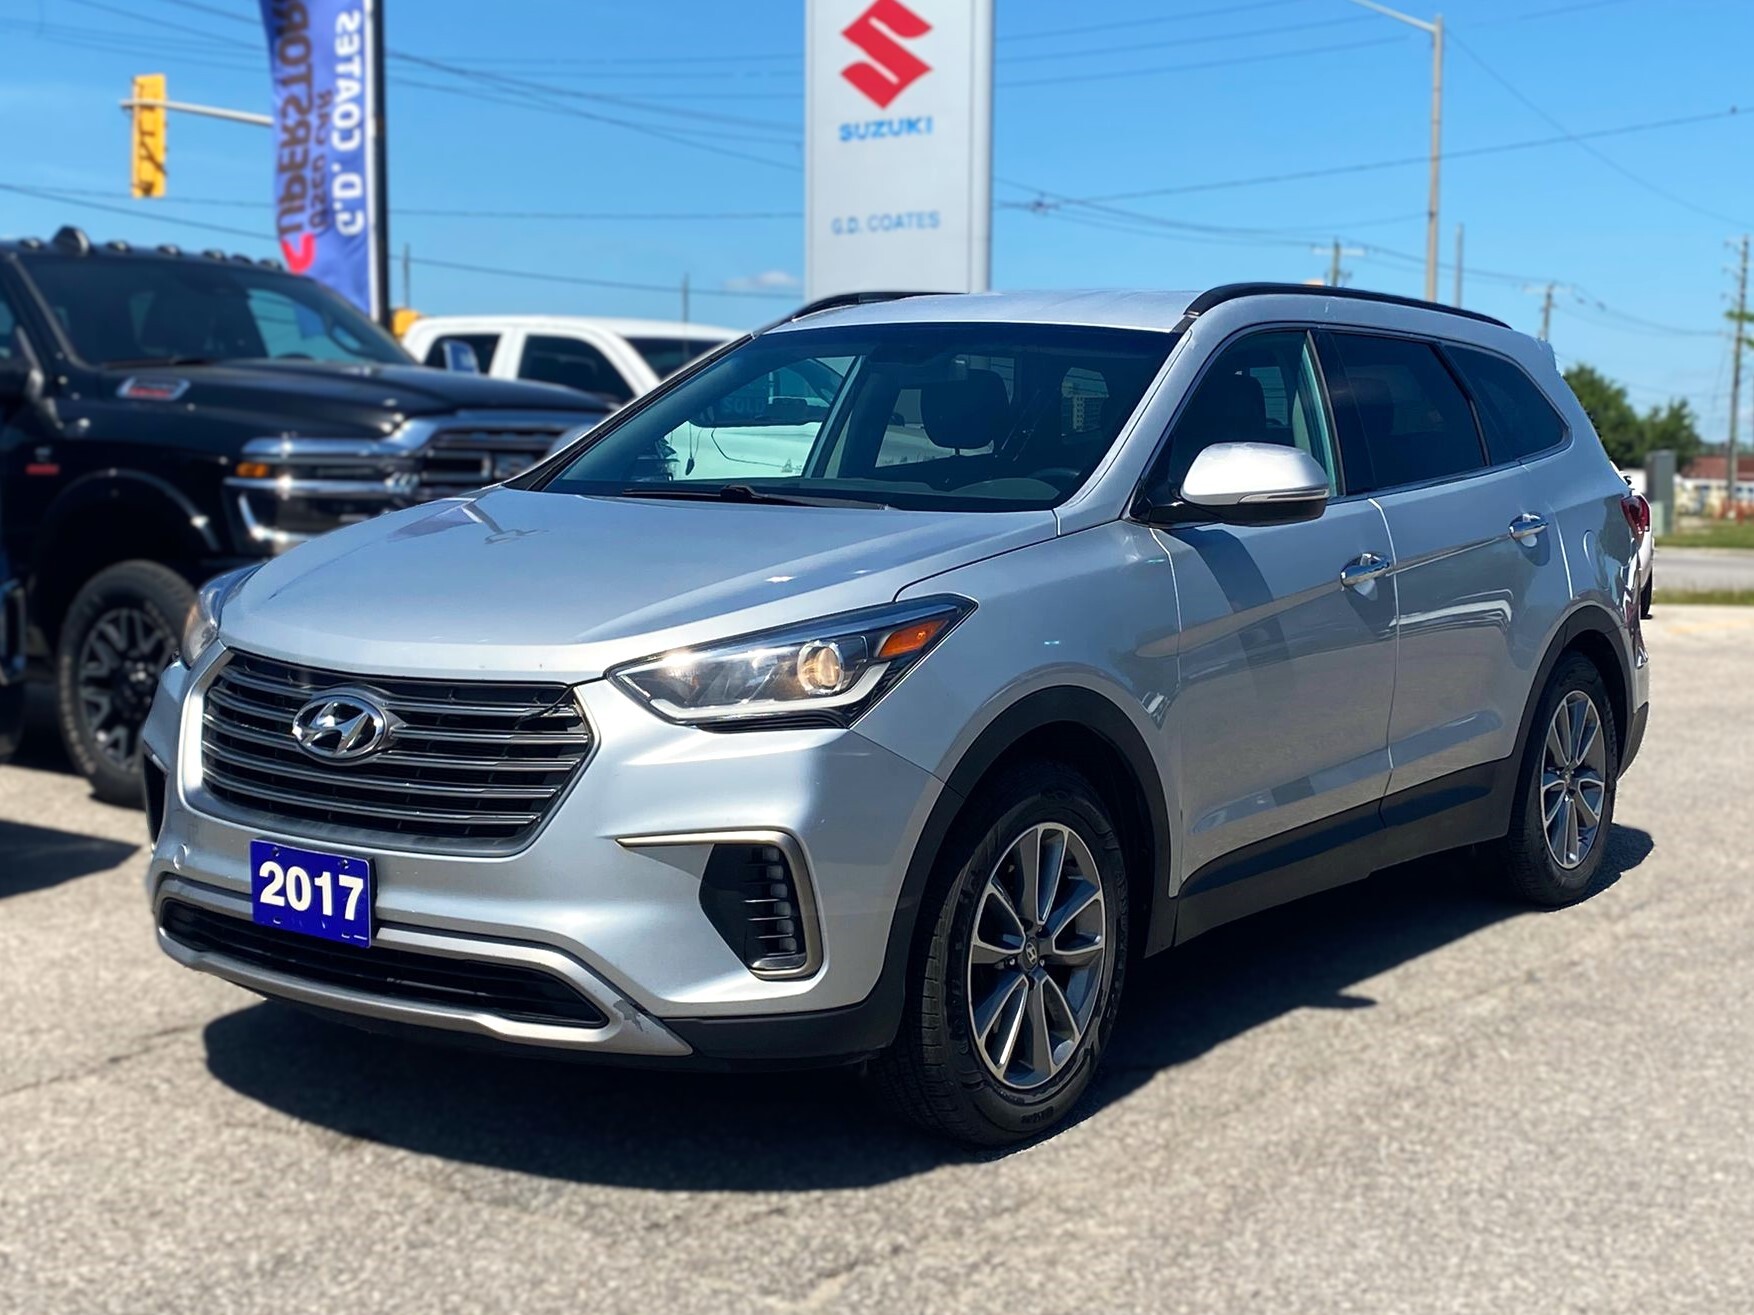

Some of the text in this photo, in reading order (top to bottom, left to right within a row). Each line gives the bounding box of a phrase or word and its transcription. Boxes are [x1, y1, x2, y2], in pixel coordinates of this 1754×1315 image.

[838, 116, 933, 142] SUZUKI
[831, 210, 941, 235] G.D. COATES
[259, 861, 364, 921] 2017
